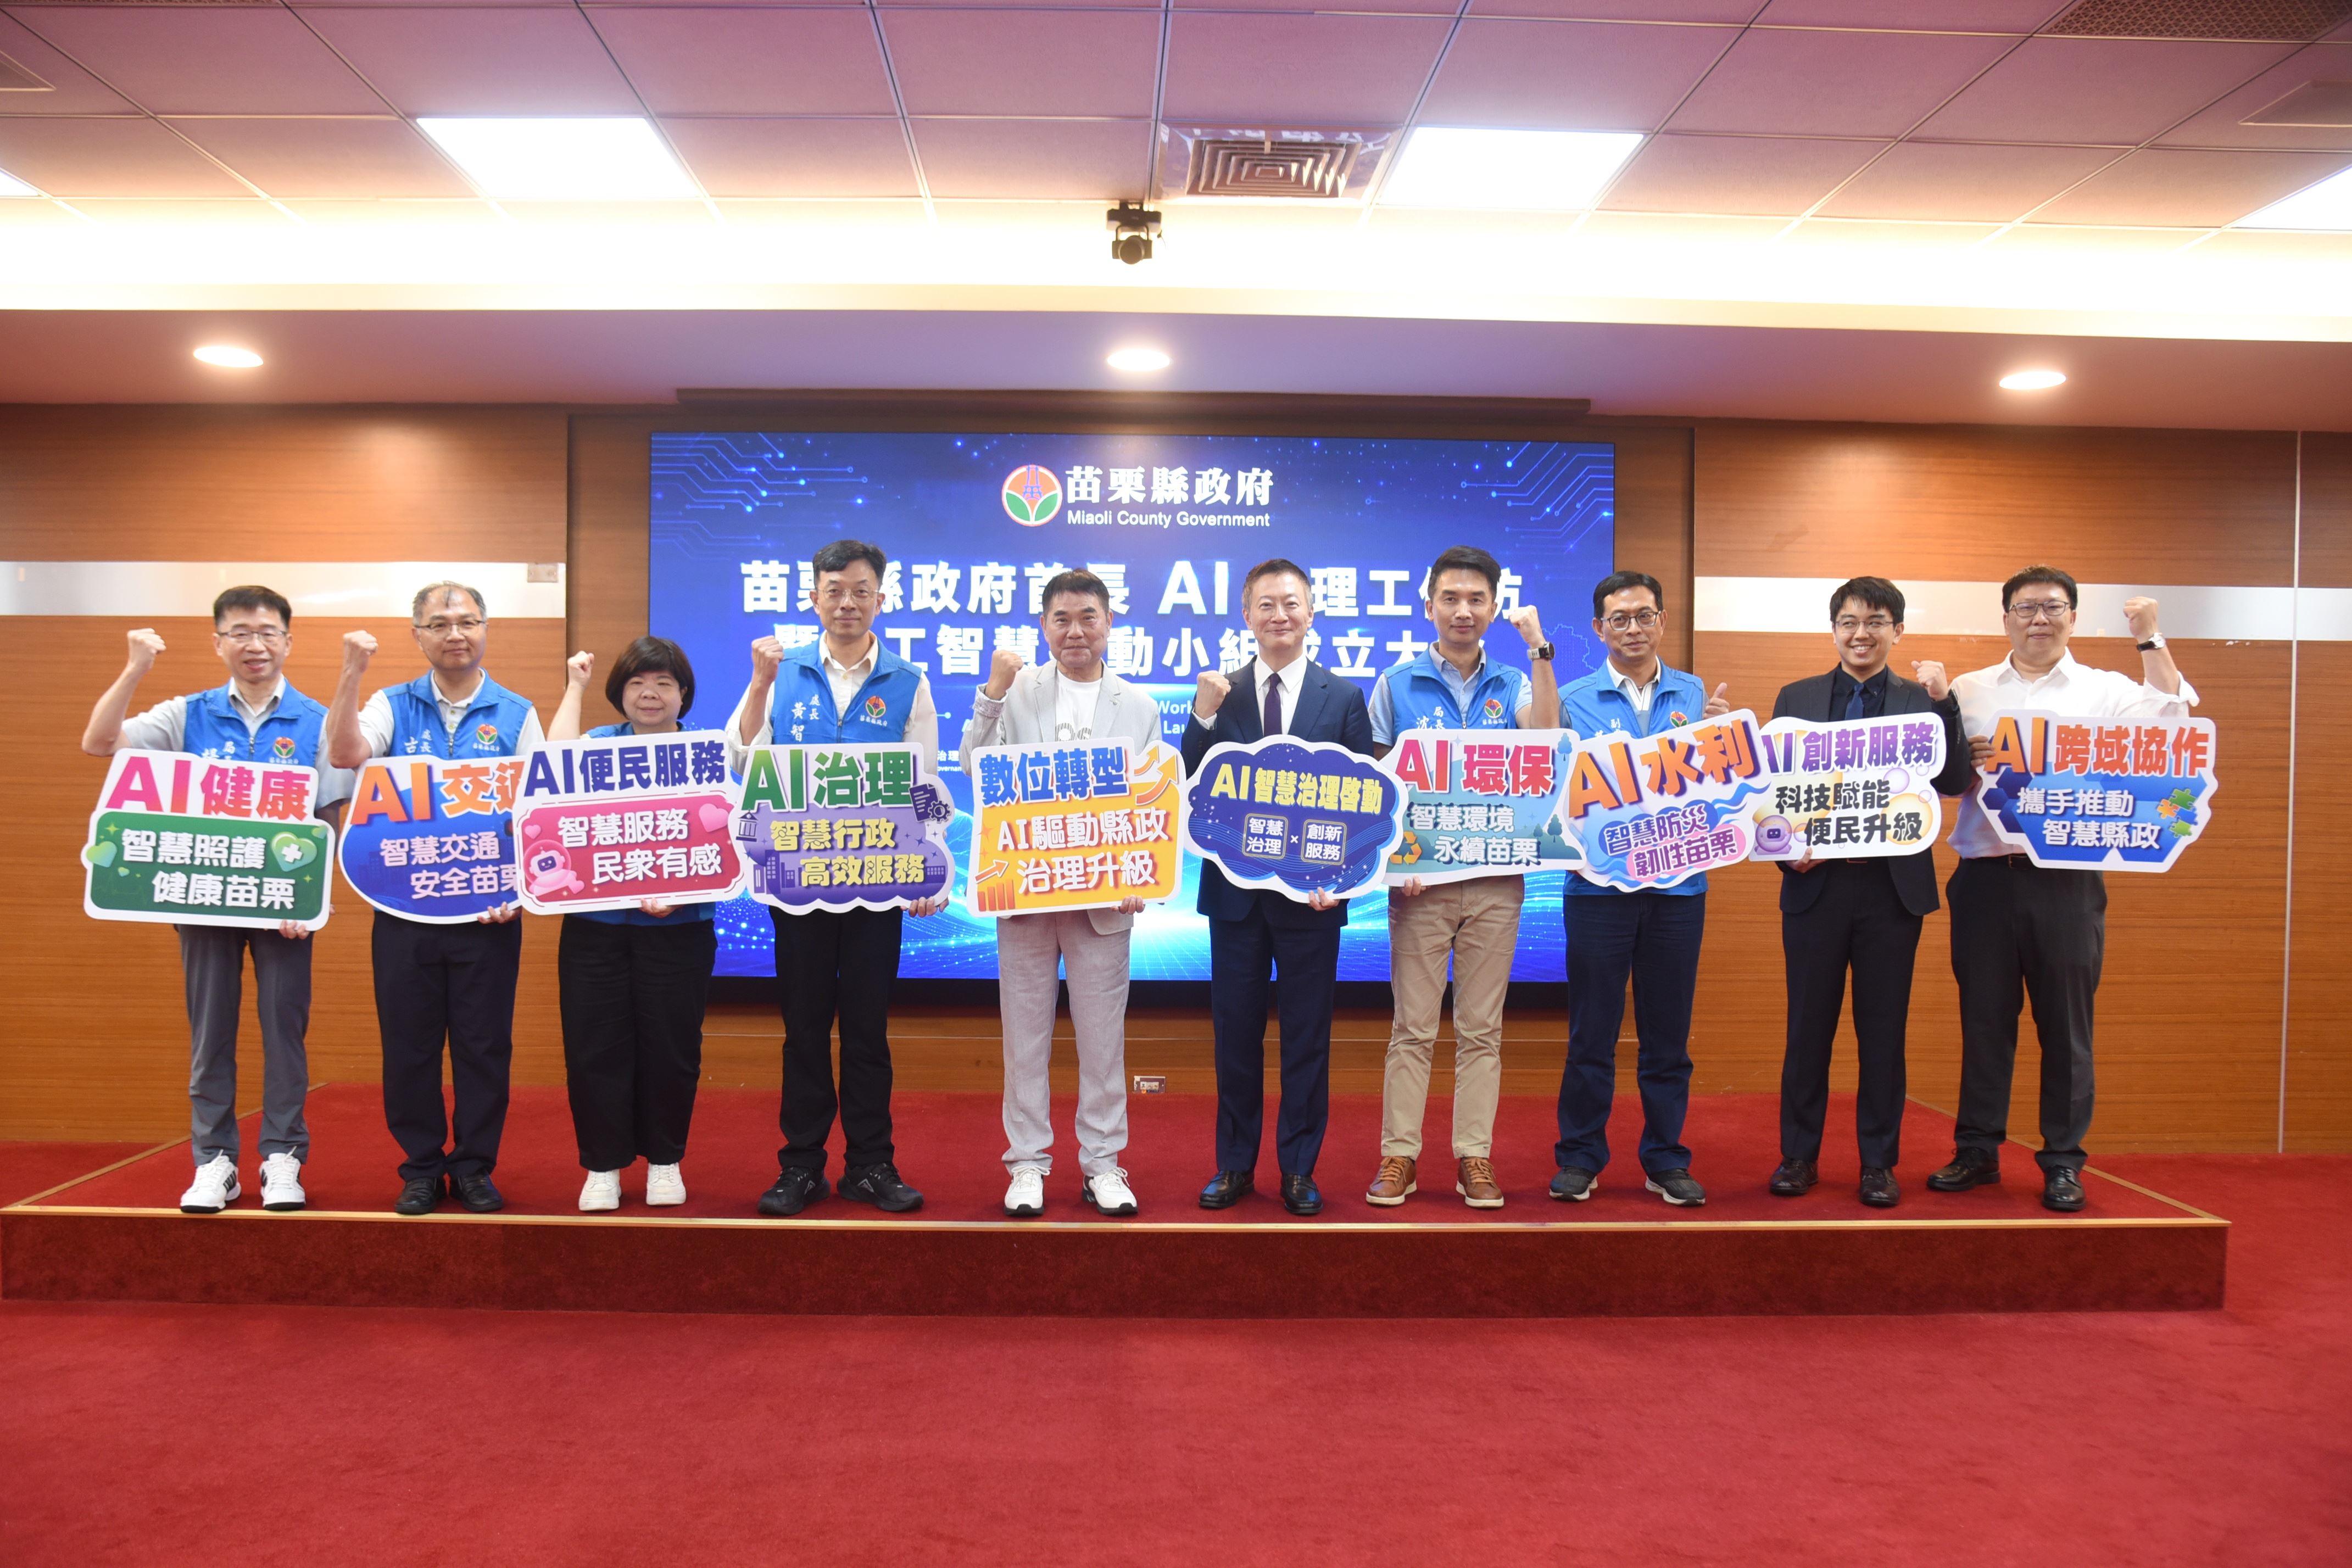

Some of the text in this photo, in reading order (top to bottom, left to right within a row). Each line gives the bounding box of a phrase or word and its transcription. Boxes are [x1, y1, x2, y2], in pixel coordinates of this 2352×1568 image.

[1066, 466, 1274, 506] 苗栗縣政府
[1067, 510, 1270, 529] Miaoli County Government
[1157, 561, 1228, 615] AI
[523, 740, 726, 797] AI便民服務
[741, 749, 913, 811] AI治理
[979, 746, 1128, 806] 數位轉型
[1569, 718, 1754, 818] AI水利
[1775, 779, 1891, 814] 科技賦能
[2016, 786, 2134, 817] 攜手推動
[557, 808, 689, 848] 智慧服務
[770, 817, 896, 851] 智慧行政
[997, 806, 1169, 851] AI驅動縣政
[1249, 817, 1284, 836] 智慧
[1307, 823, 1342, 842] 創新
[1411, 804, 1514, 833] 智慧環境
[1604, 804, 1709, 855] 智慧防災
[1804, 812, 1923, 846] 便民升級
[2042, 818, 2161, 850] 智慧縣政
[121, 828, 267, 869] 智慧照護
[379, 830, 500, 867] 智慧交通
[1246, 836, 1282, 855] 治理
[1305, 842, 1341, 861] 服務
[1434, 835, 1540, 864] 永續苗栗
[410, 863, 518, 899] 安全苗栗
[800, 853, 925, 888] 高效服務
[1016, 850, 1156, 894] 治理升級
[152, 870, 296, 910] 健康苗栗
